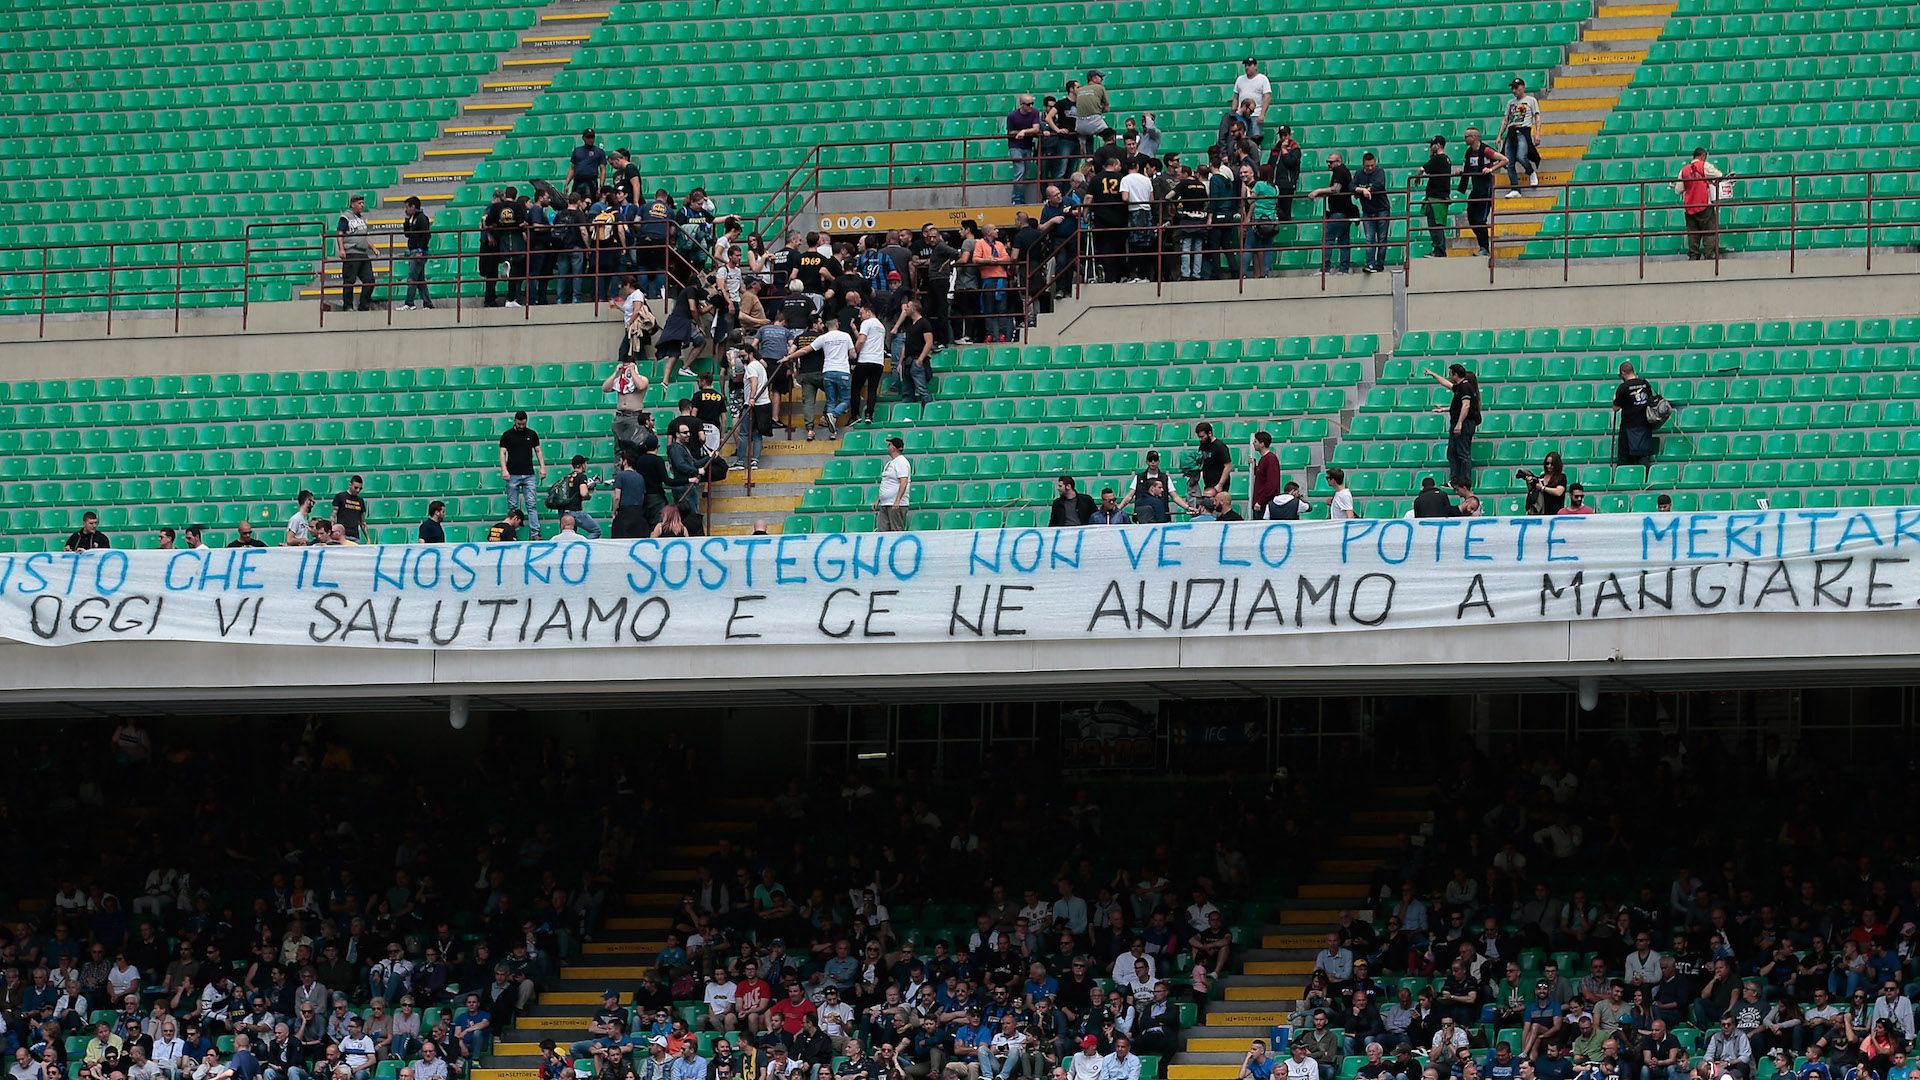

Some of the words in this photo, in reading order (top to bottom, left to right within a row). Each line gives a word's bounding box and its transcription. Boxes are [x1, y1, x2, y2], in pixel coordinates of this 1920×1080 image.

[1101, 177, 1119, 194] 12
[949, 211, 967, 219] USCITA
[800, 257, 821, 266] 1969
[701, 392, 722, 402] 1969
[0, 550, 129, 596] ISTO
[165, 549, 267, 591] CHE
[297, 550, 338, 590] IL
[374, 540, 592, 593] NOSTRO
[627, 533, 923, 595] SOSTEGNO
[969, 529, 1084, 576] NON
[1120, 524, 1193, 570] VE
[1218, 523, 1293, 568] LO
[1341, 516, 1587, 565] POTETE
[1642, 508, 1920, 560] MERITAR
[30, 594, 163, 640] OGGI
[216, 598, 263, 636] VI
[309, 593, 670, 645] SALUTIAMO
[726, 596, 766, 639] E
[819, 588, 899, 638] CE
[949, 585, 1034, 636] NE
[1087, 573, 1397, 632] ANDIAMO
[1457, 574, 1494, 619] A
[1540, 557, 1910, 617] MANGIARE
[1205, 726, 1228, 741] IFC
